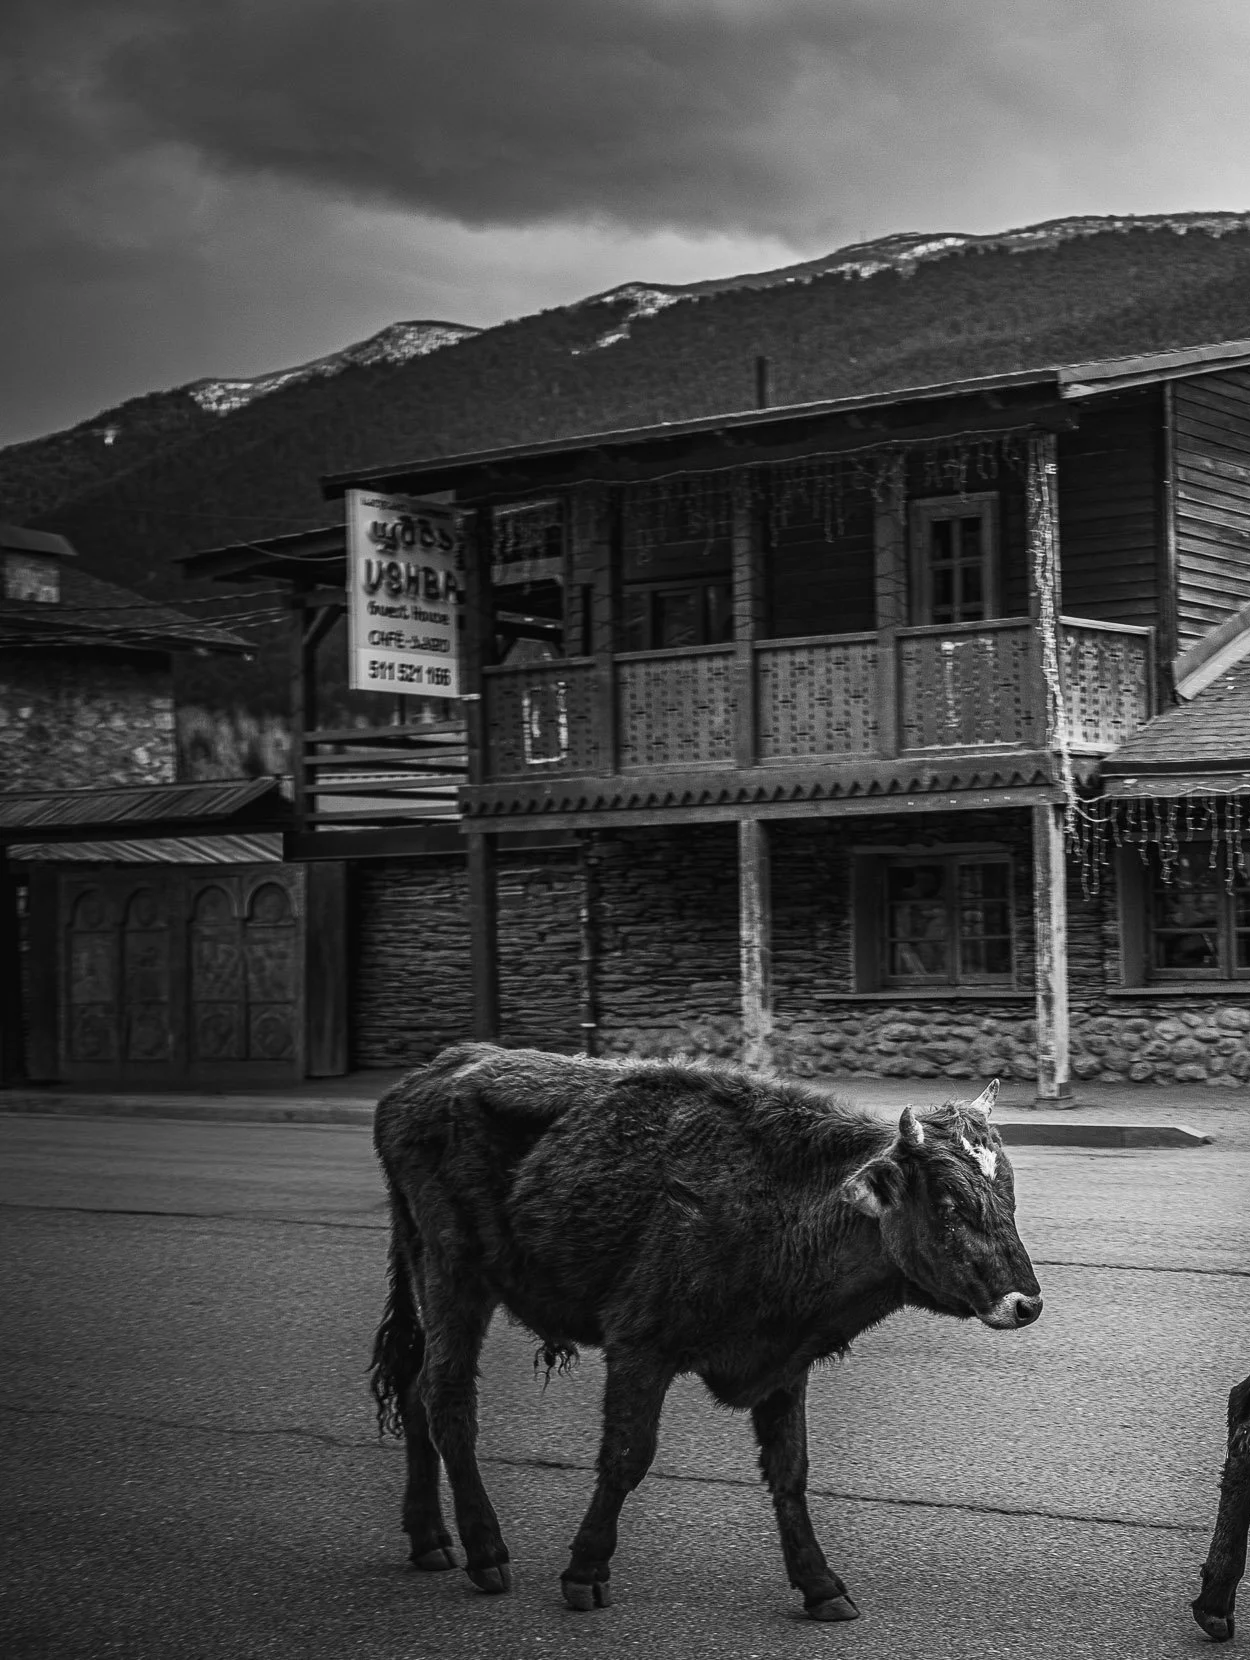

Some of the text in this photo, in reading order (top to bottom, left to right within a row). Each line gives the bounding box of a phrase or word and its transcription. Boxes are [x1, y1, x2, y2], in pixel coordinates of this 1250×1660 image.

[363, 559, 457, 601] USHBA
[367, 600, 449, 626] Guest House
[368, 660, 395, 680] 511
[397, 663, 423, 683] 521
